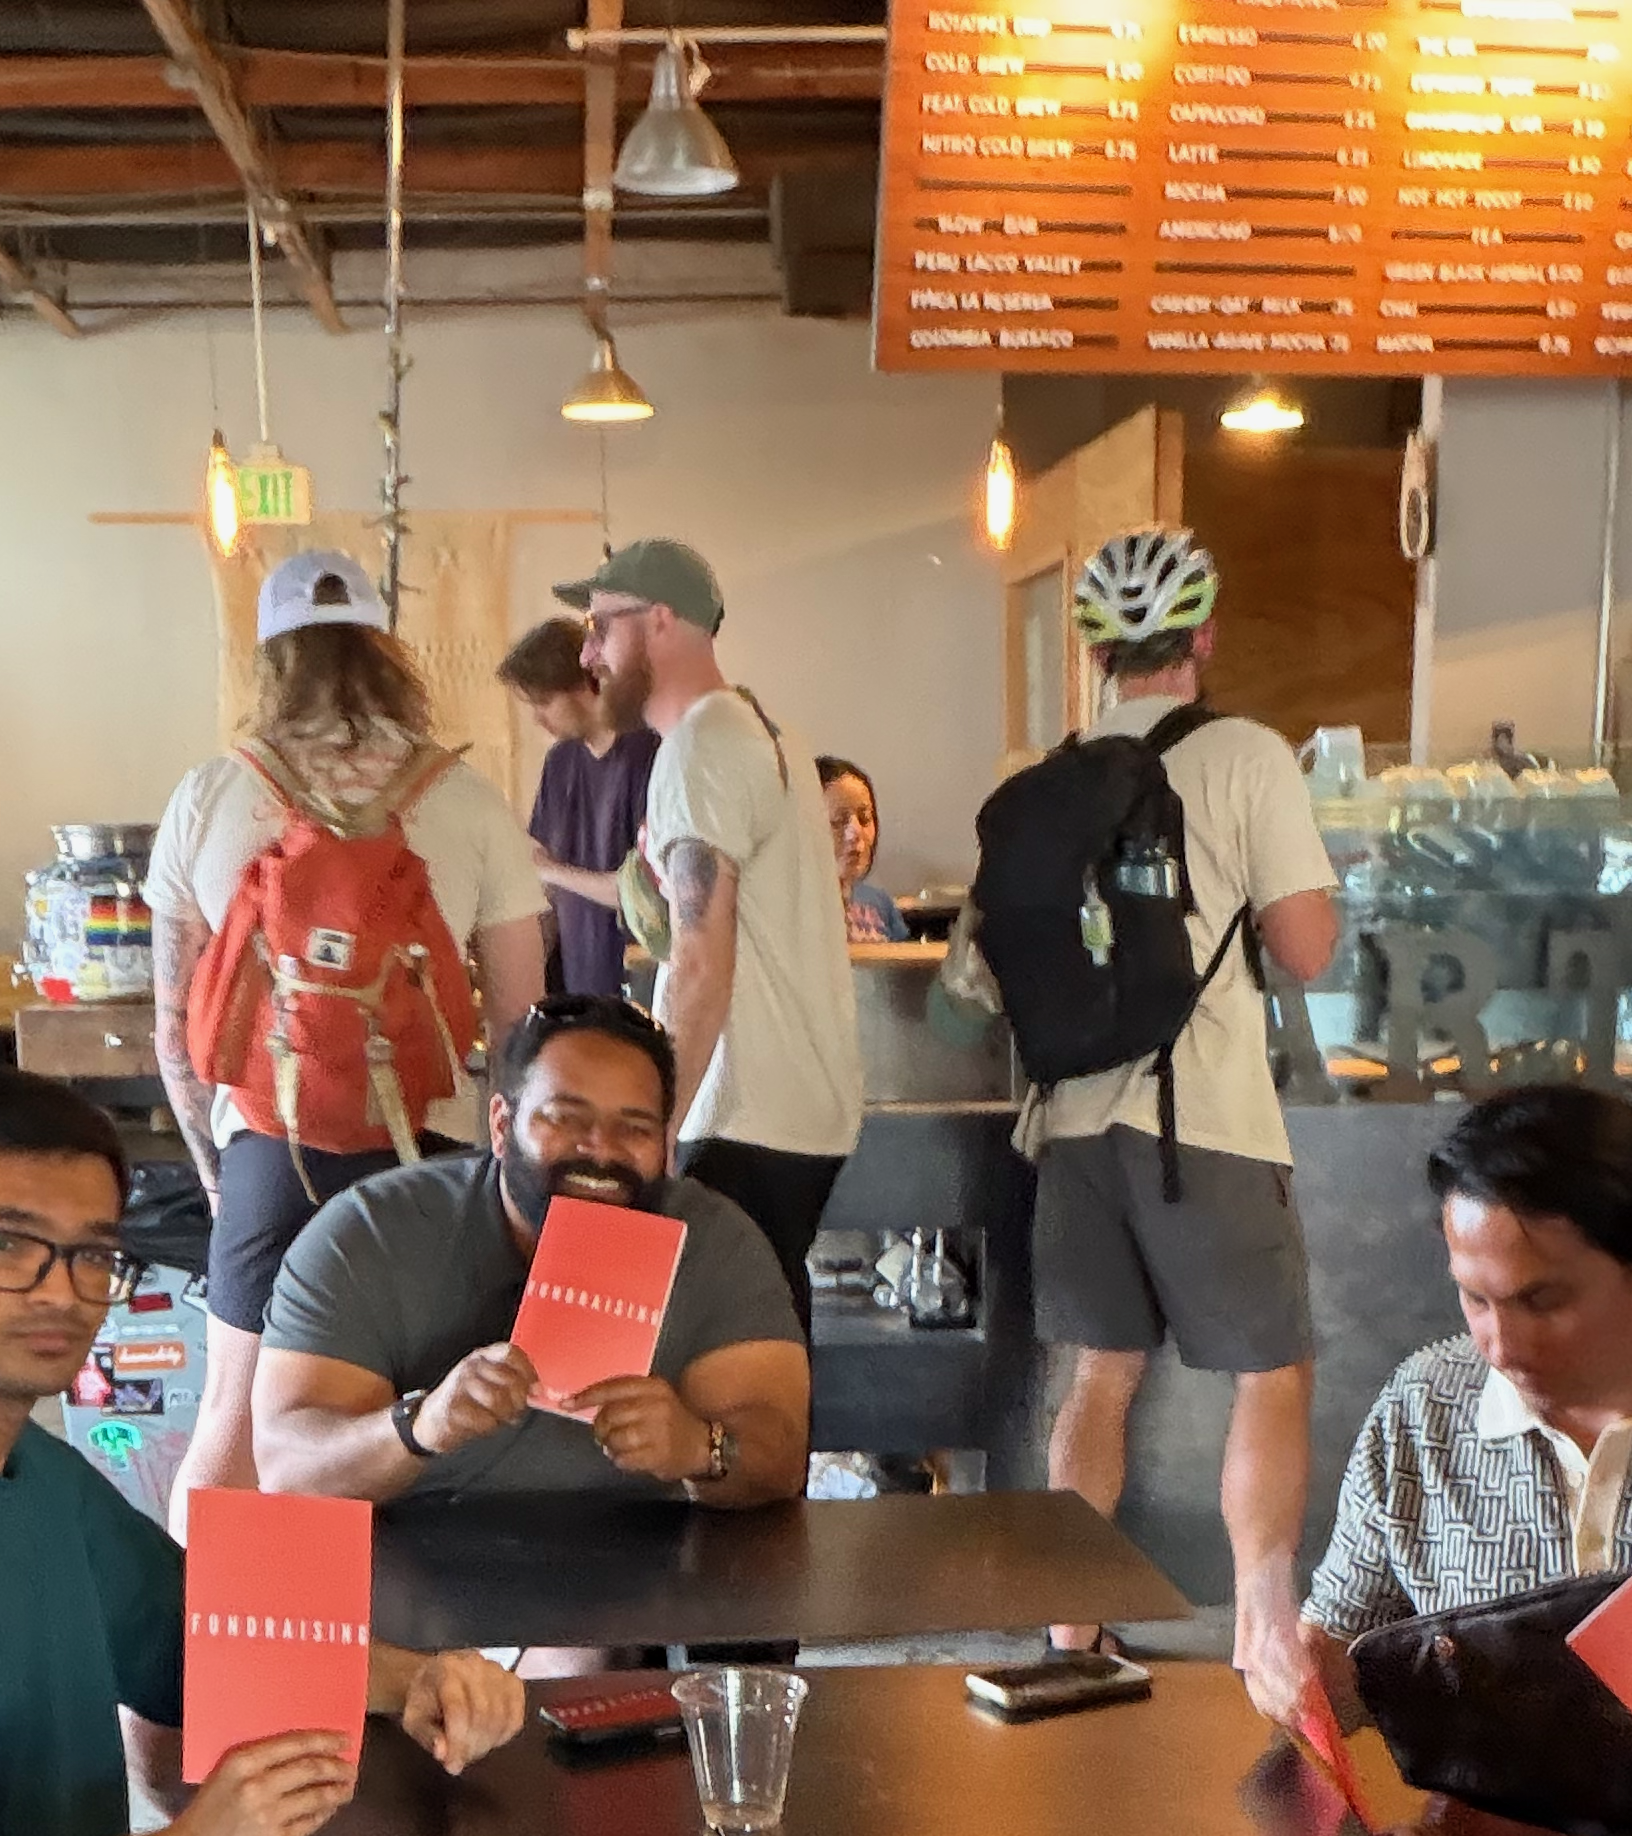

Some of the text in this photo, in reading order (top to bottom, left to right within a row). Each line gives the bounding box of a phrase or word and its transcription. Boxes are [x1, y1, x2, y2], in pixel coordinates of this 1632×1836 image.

[922, 132, 976, 154] NITRO
[979, 135, 1024, 157] COLD
[1168, 142, 1219, 164] LATTE
[238, 469, 293, 517] EXIT
[191, 1612, 368, 1648] FUNDRAISING
